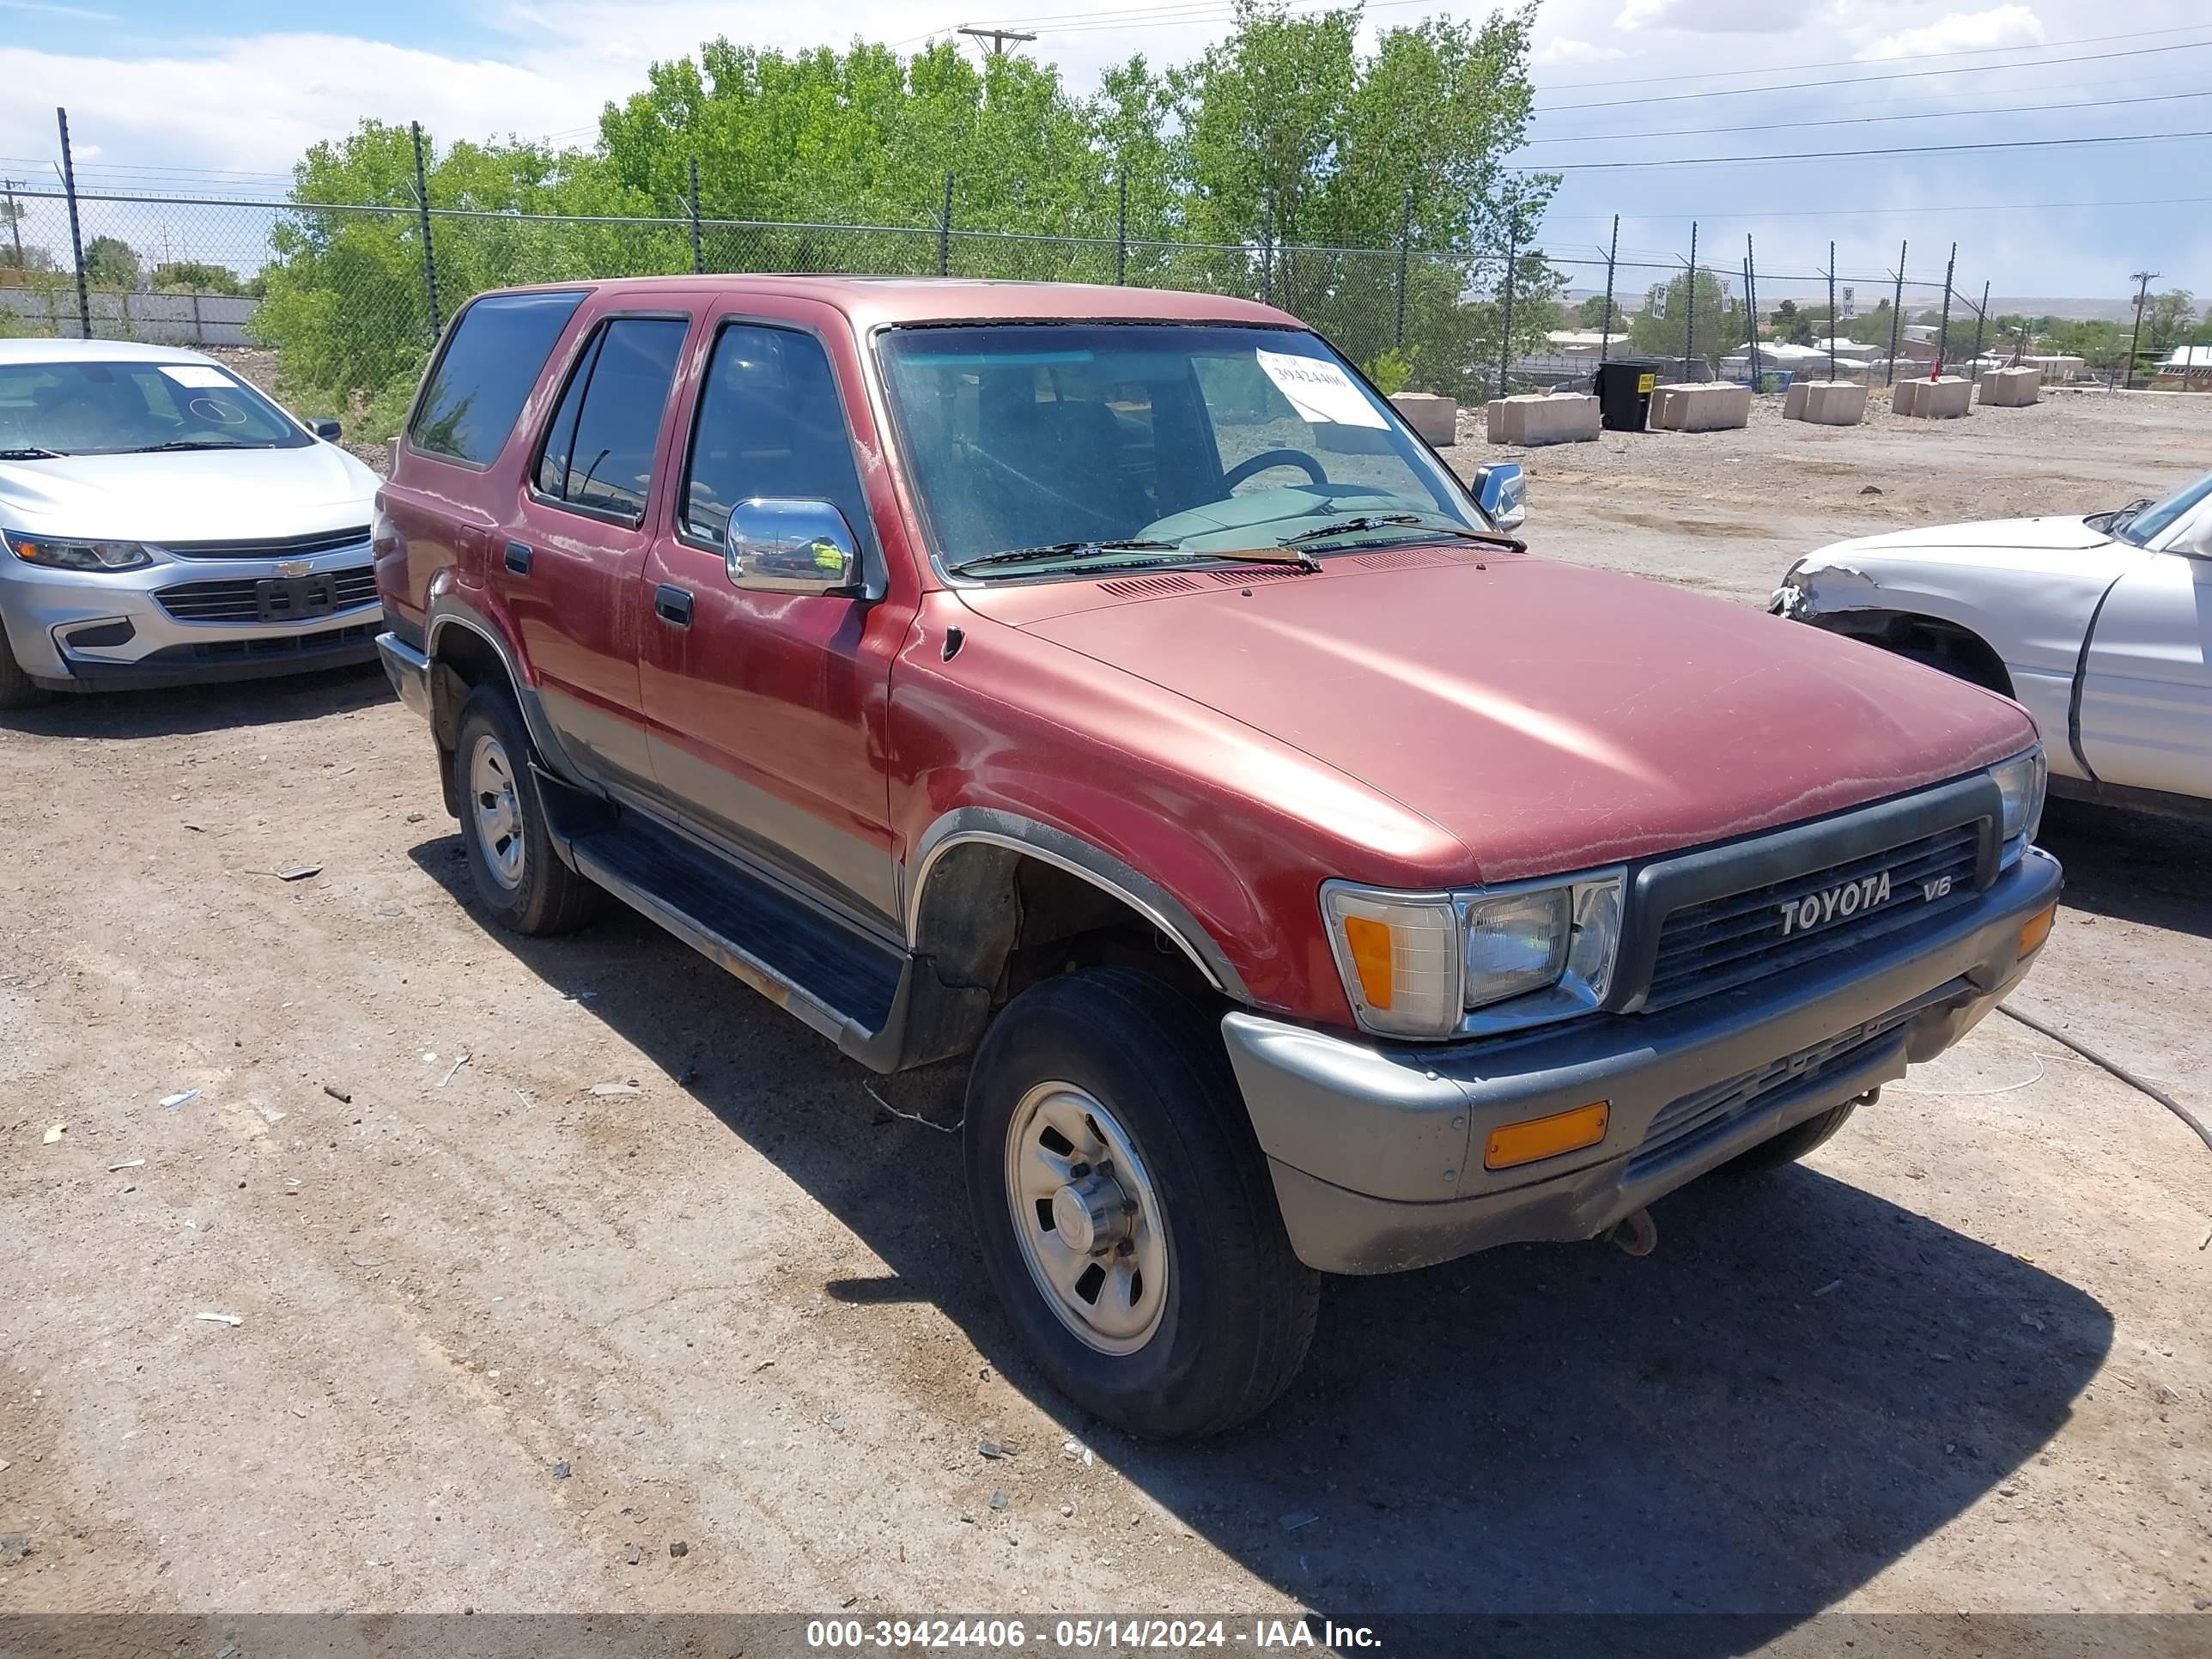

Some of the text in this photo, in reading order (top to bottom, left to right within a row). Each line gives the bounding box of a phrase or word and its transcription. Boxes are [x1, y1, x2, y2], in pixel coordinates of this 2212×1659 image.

[1657, 287, 1666, 301] SF
[1845, 289, 1852, 301] SF
[1654, 302, 1665, 318] VIC
[1844, 304, 1854, 315] VIC
[1781, 872, 1953, 936] TOYOTA V6
